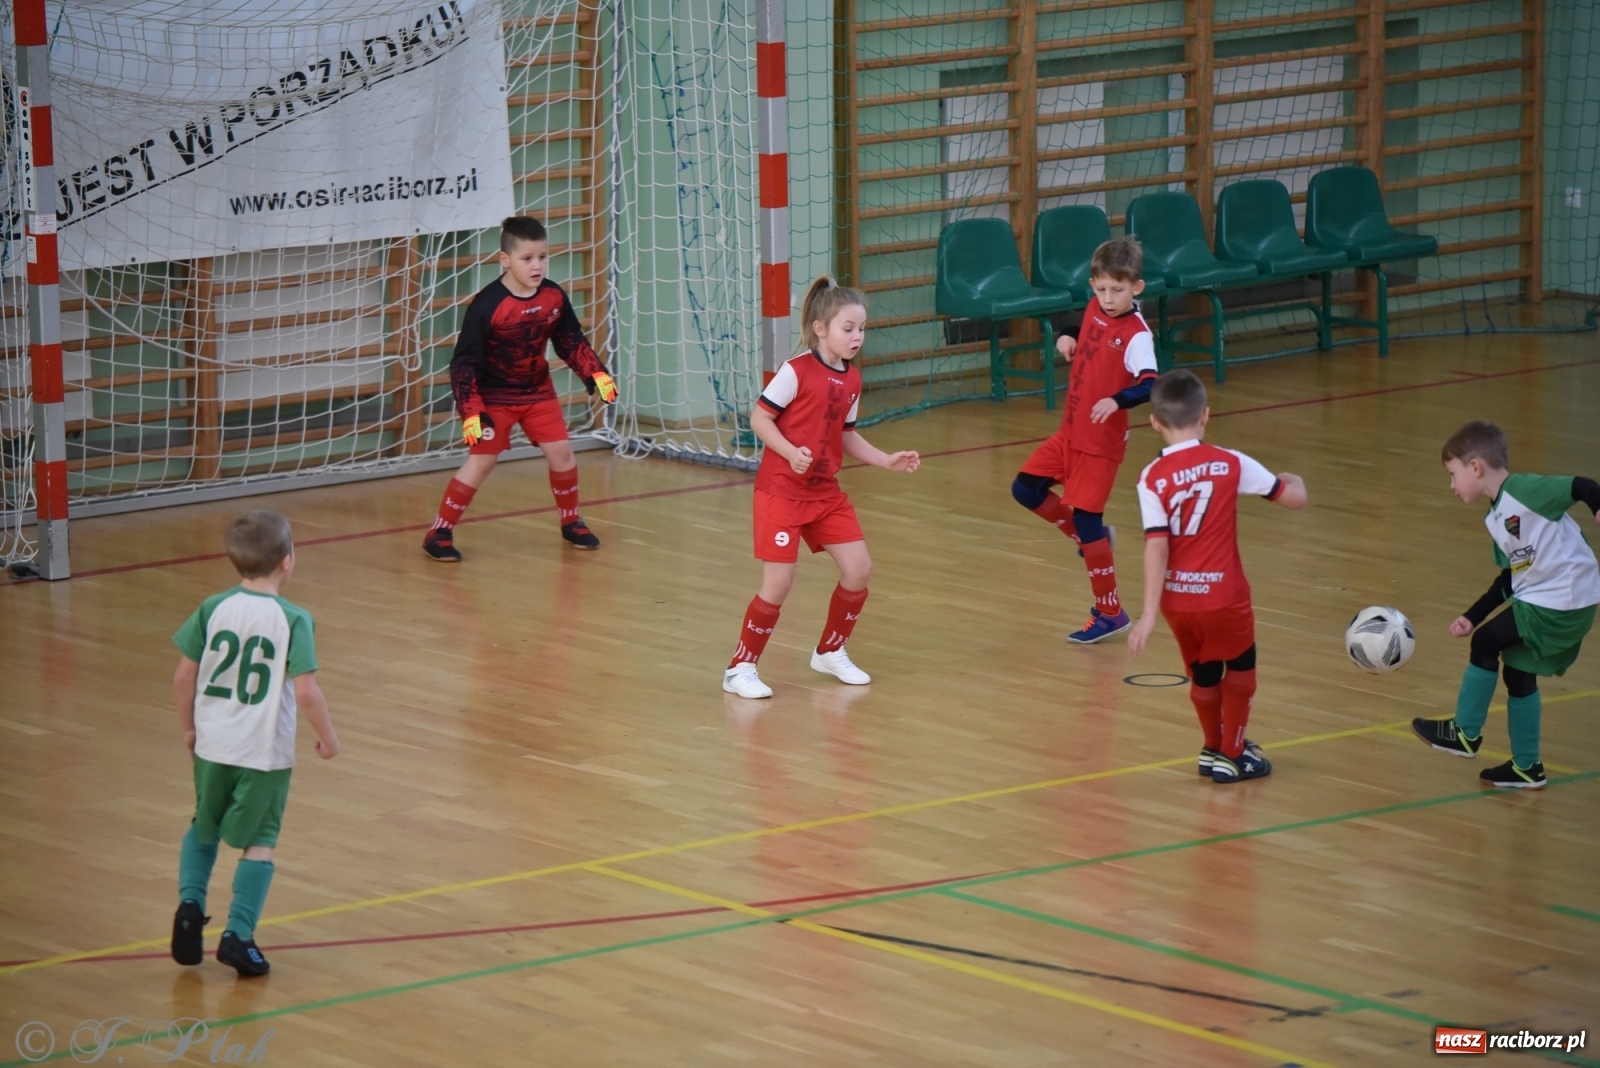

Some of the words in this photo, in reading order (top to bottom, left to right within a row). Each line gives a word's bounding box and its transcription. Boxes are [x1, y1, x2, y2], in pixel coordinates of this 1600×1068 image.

[56, 139, 156, 222] JEST
[167, 114, 214, 166] W
[1172, 461, 1229, 486] UNITED
[1169, 480, 1214, 536] 17
[1175, 570, 1225, 583] TWORZYMY
[203, 629, 276, 706] 26
